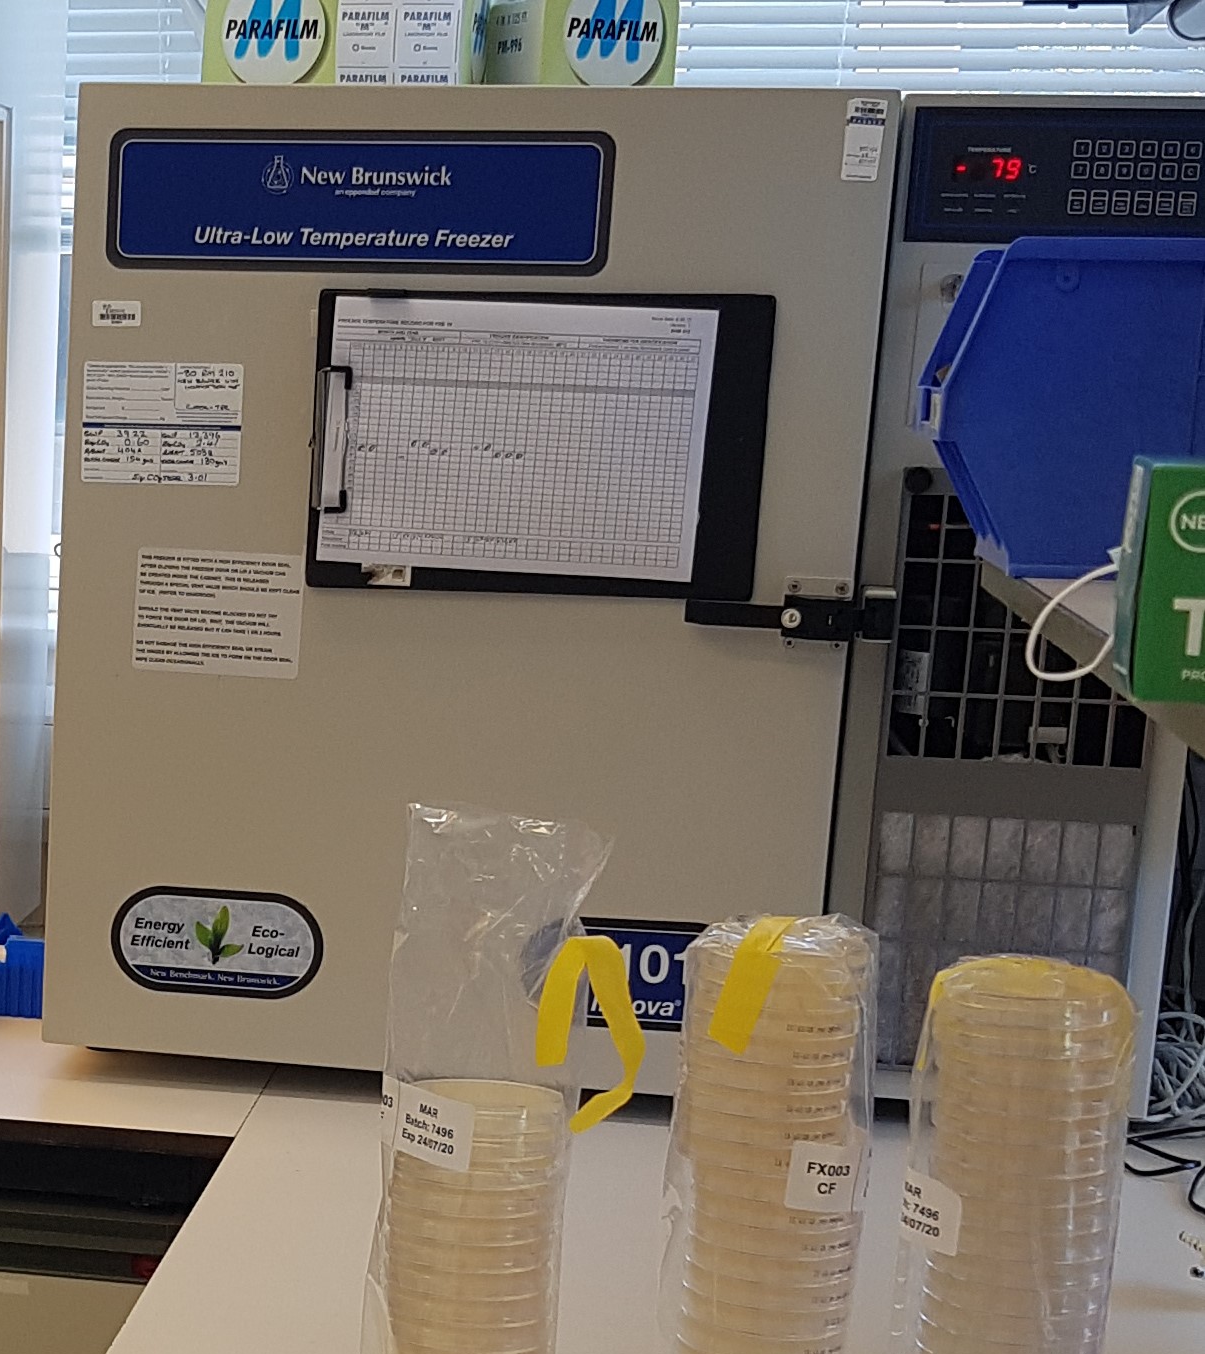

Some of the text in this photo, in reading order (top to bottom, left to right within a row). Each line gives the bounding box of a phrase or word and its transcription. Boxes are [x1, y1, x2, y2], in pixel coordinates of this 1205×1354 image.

[342, 12, 389, 21] PARAFILM
[404, 12, 451, 21] PARAFILM
[226, 19, 318, 40] PARAFILM
[567, 17, 658, 42] PARAFILM
[340, 74, 386, 83] PARAFILM
[401, 74, 448, 83] PARAFILM
[300, 166, 451, 186] New Brunswick
[194, 226, 515, 249] Ultra-Low Temperature Freezer
[134, 917, 185, 934] Energy
[251, 925, 285, 939] Eco-
[130, 934, 190, 950] Efficient
[247, 943, 300, 958] Logical
[150, 968, 166, 978] New
[217, 973, 234, 982] New
[419, 1103, 438, 1119] MAR
[406, 1113, 454, 1139] Batch: 7496
[402, 1127, 416, 1144] Exp
[806, 1162, 850, 1177] FX003
[817, 1182, 837, 1194] CF
[913, 1203, 939, 1221] 7496
